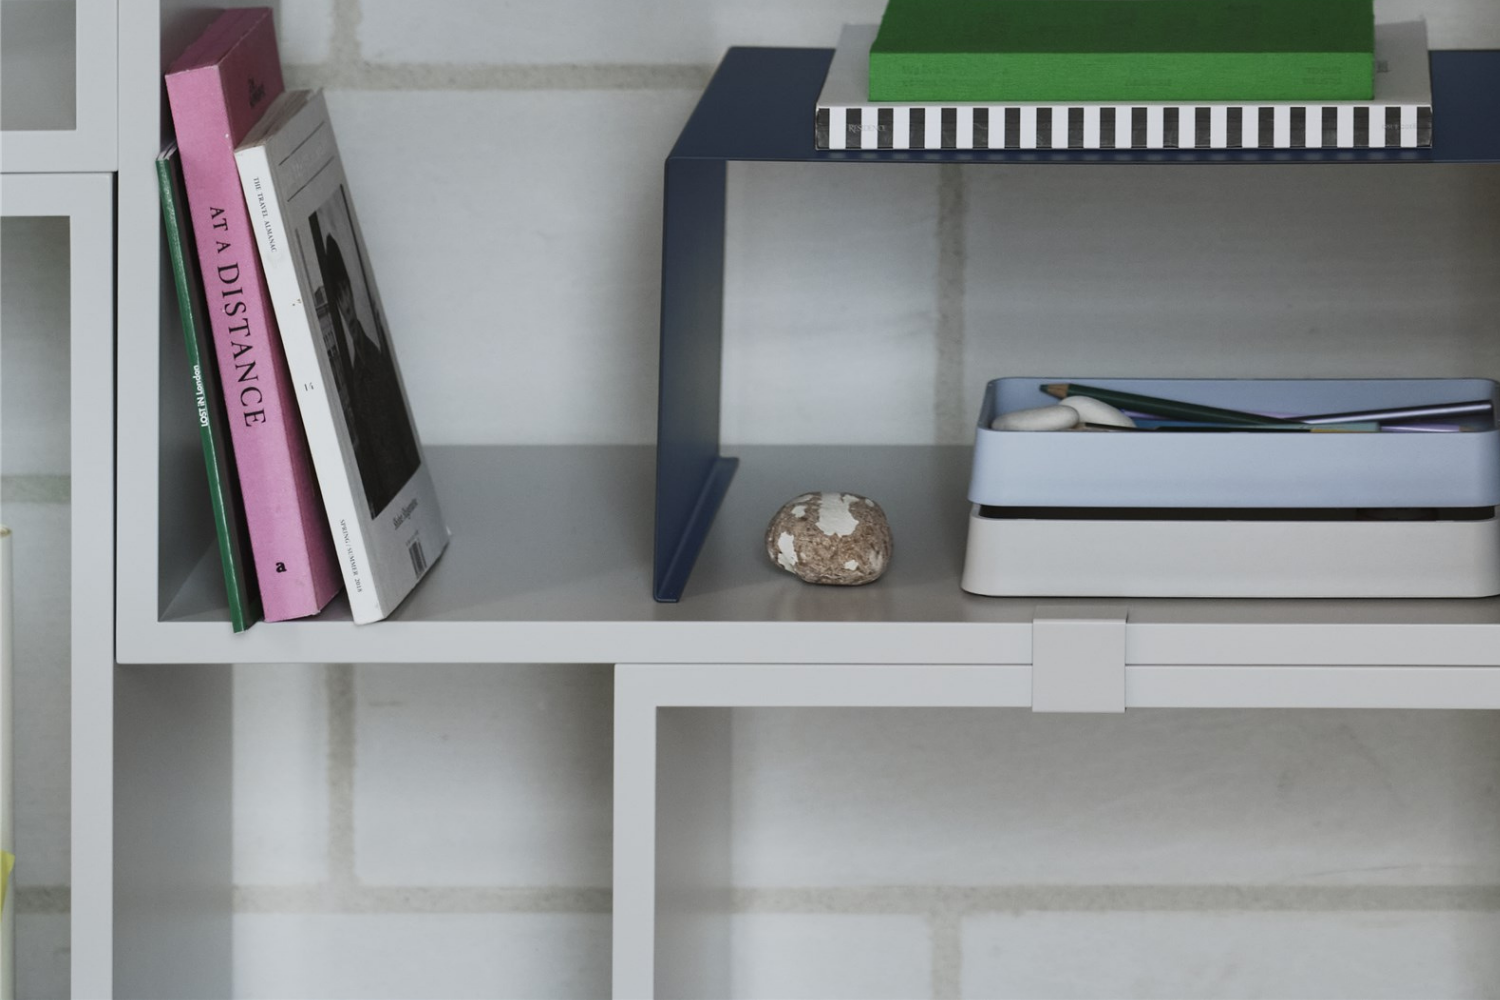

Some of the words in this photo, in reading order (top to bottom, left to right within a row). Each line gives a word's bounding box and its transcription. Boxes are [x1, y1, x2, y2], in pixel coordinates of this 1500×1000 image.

[253, 176, 262, 190] THE
[257, 192, 268, 218] TRAVEL
[210, 206, 228, 232] AT
[216, 240, 231, 254] A
[264, 220, 277, 253] ALMANAC
[217, 262, 266, 427] DISTANCE
[192, 364, 204, 395] London
[198, 408, 209, 427] LOST
[340, 519, 350, 543] SPRING
[347, 547, 358, 576] SUMMER
[275, 561, 287, 573] a
